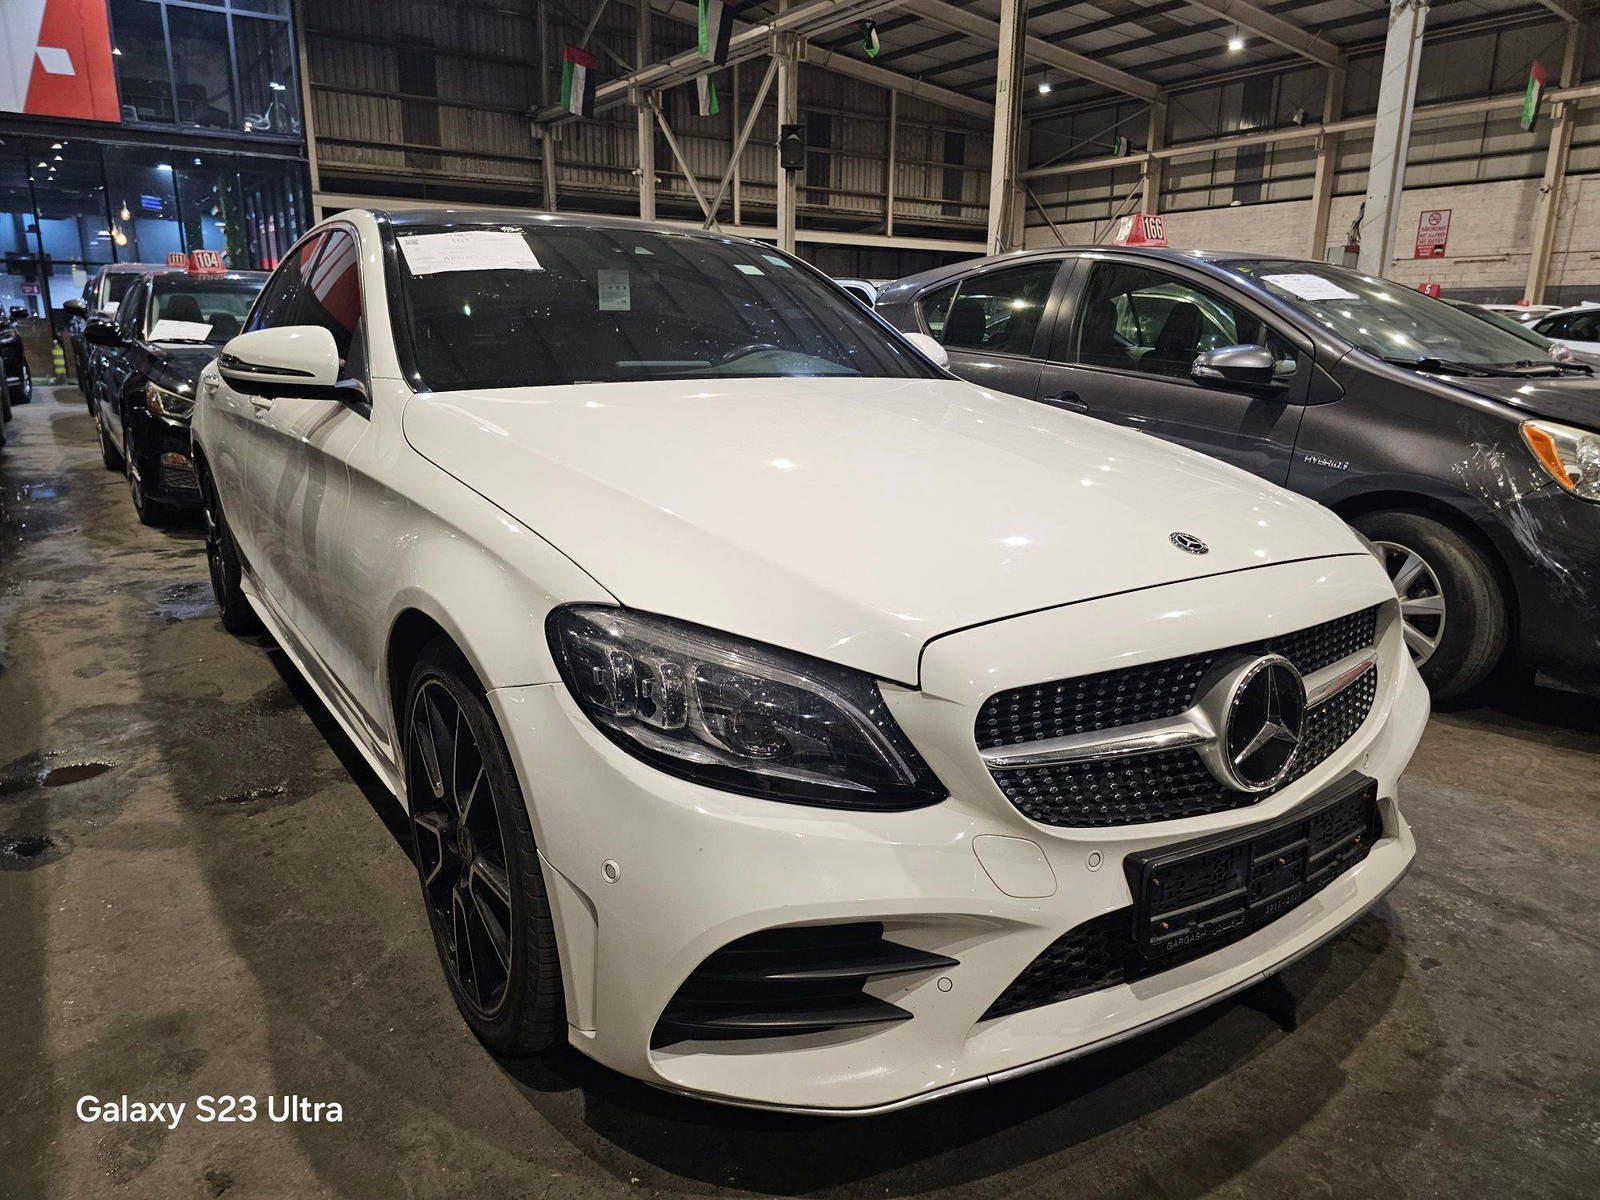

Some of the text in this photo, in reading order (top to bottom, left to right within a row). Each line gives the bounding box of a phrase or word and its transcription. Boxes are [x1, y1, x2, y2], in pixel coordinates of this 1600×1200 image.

[1144, 216, 1164, 239] 166
[198, 252, 218, 268] 104
[1424, 285, 1432, 294] 5
[1167, 930, 1207, 950] GARGASH
